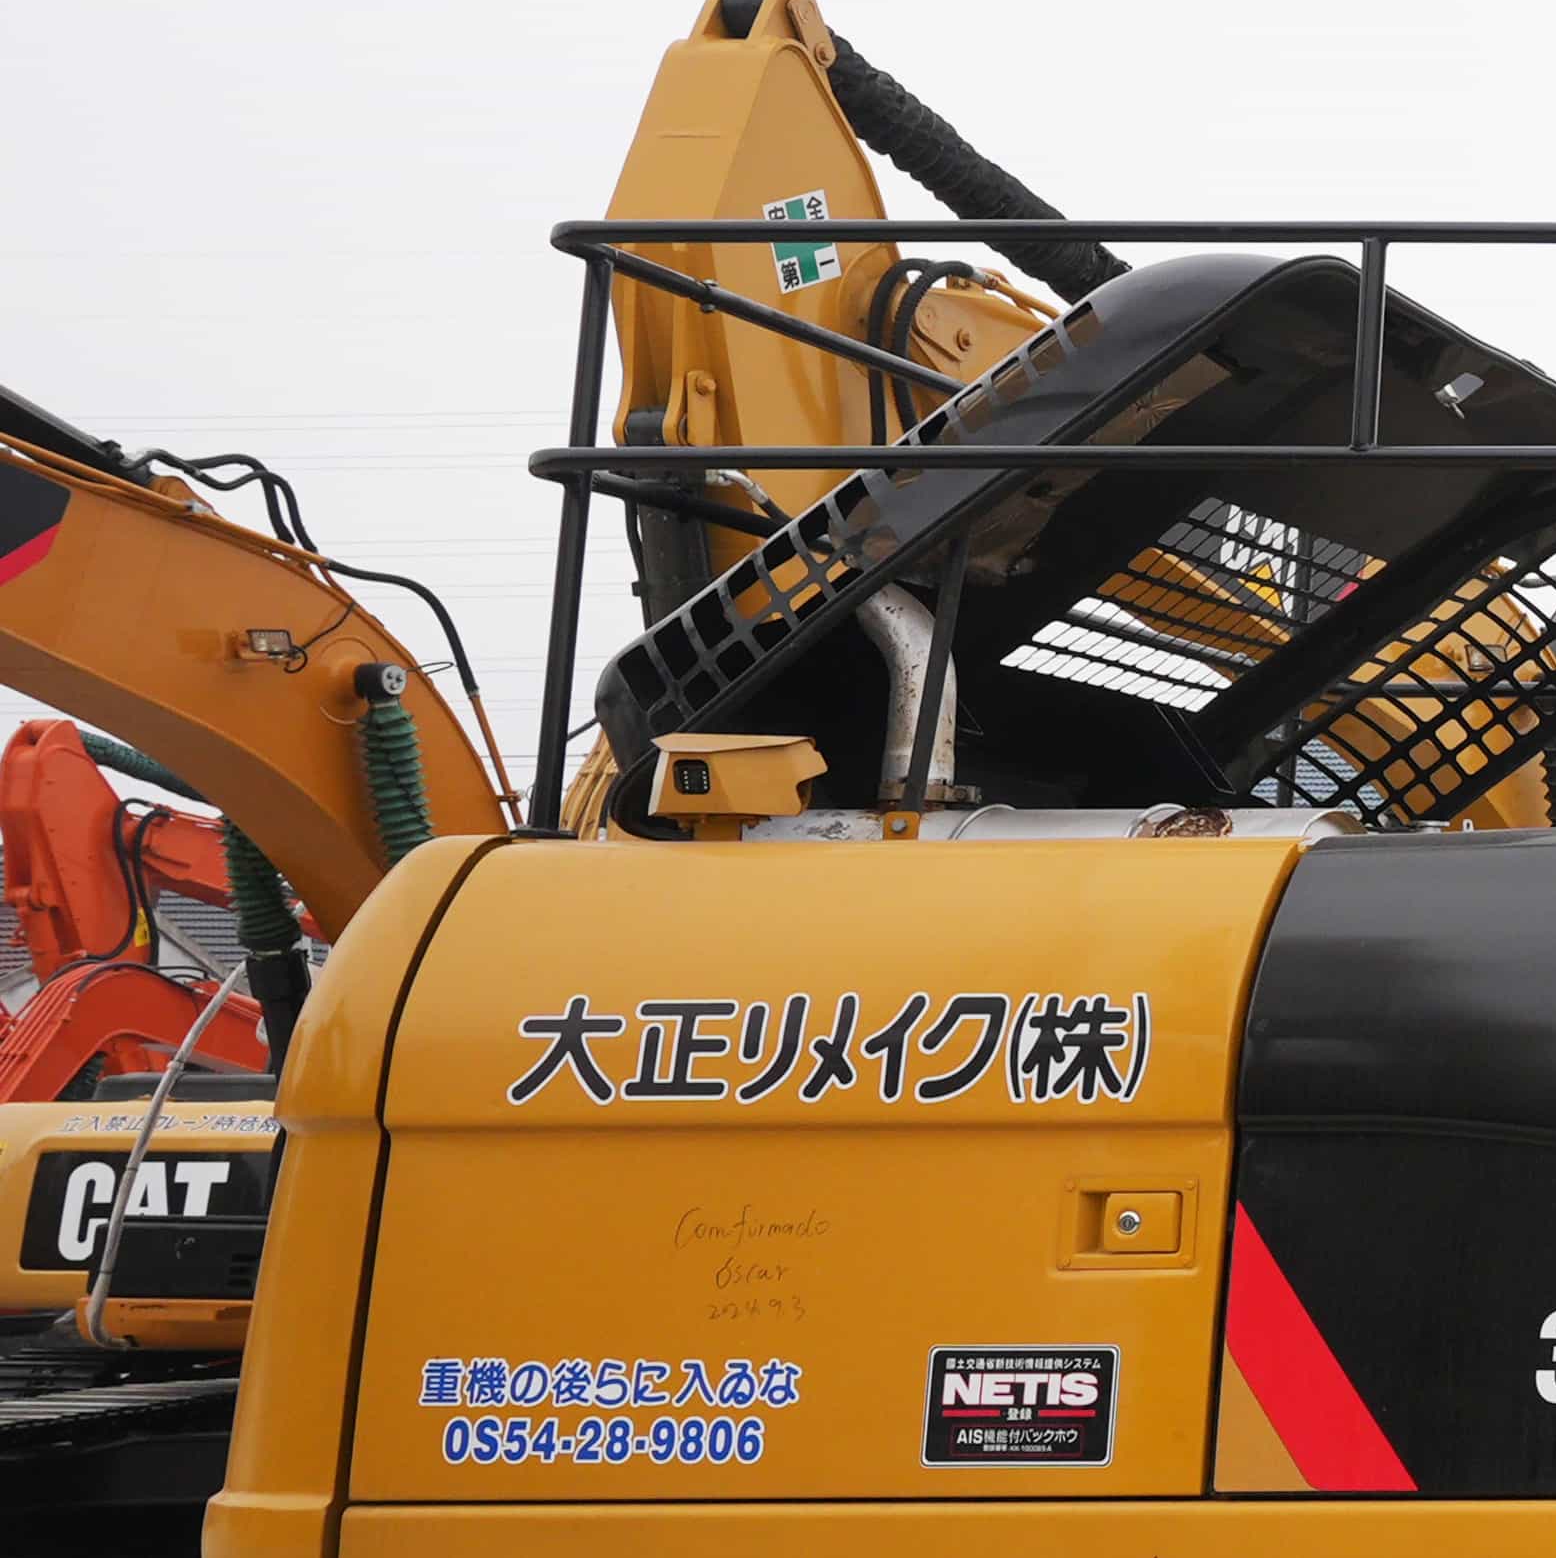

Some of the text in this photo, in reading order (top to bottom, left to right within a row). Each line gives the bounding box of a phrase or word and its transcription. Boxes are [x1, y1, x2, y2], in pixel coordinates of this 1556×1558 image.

[507, 992, 1152, 1104] 大正リメイク(株)
[57, 1161, 230, 1261] CAT
[941, 1372, 1099, 1406] NETIS
